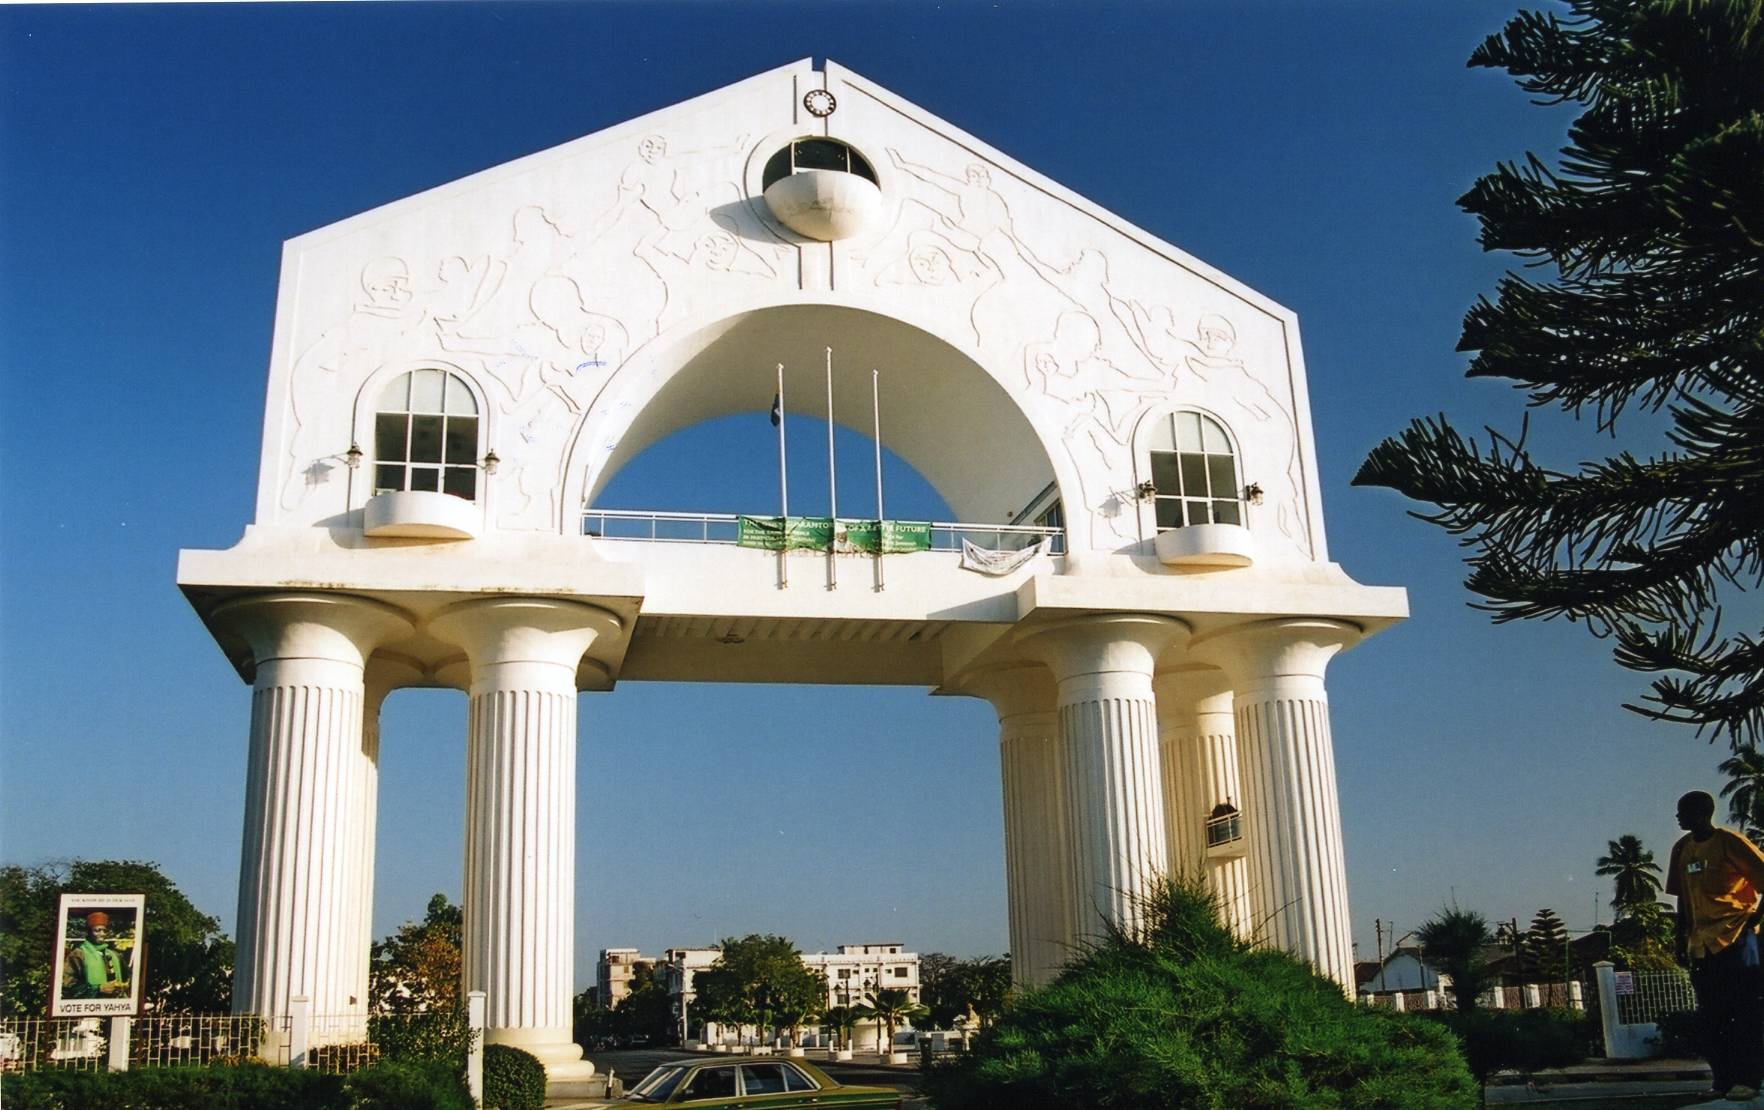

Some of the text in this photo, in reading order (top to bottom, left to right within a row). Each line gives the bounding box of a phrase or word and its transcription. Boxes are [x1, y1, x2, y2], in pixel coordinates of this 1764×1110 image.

[60, 1003, 131, 1013] VOTE FOR YAHYA
